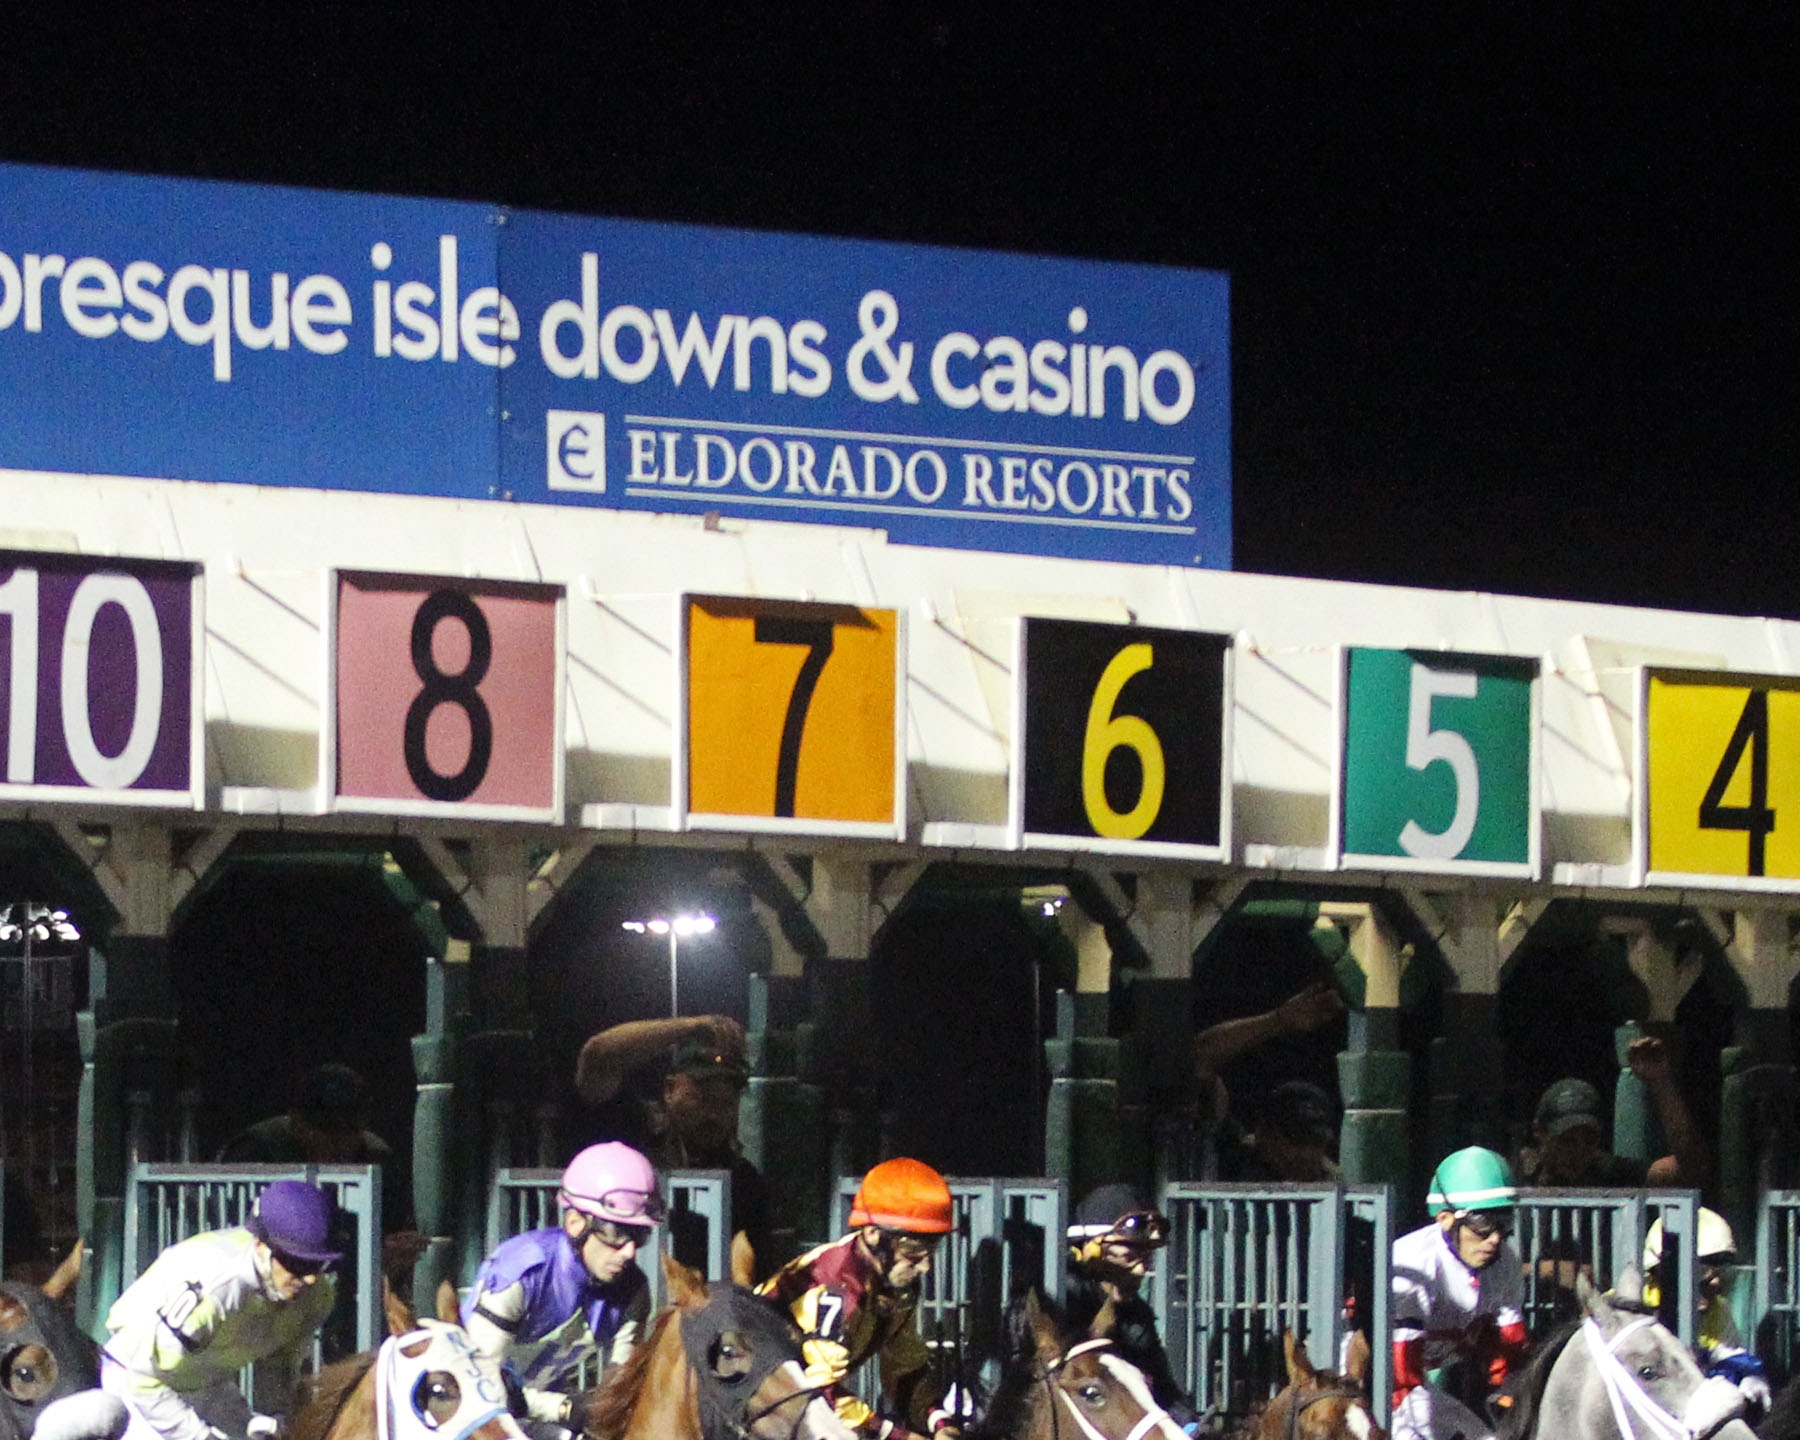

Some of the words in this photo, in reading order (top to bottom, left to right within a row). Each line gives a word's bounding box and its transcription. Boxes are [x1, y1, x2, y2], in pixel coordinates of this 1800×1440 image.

[370, 234, 521, 369] isle
[539, 252, 833, 397] downs
[846, 289, 919, 405] &
[931, 307, 1196, 426] casino
[628, 429, 949, 505] ELDORADO
[961, 453, 1193, 522] RESORTS
[404, 588, 492, 802] 8
[754, 618, 834, 817] 7
[1081, 642, 1166, 840] 6
[1398, 663, 1480, 860] 5
[1698, 688, 1776, 876] 4
[819, 1294, 842, 1337] 7
